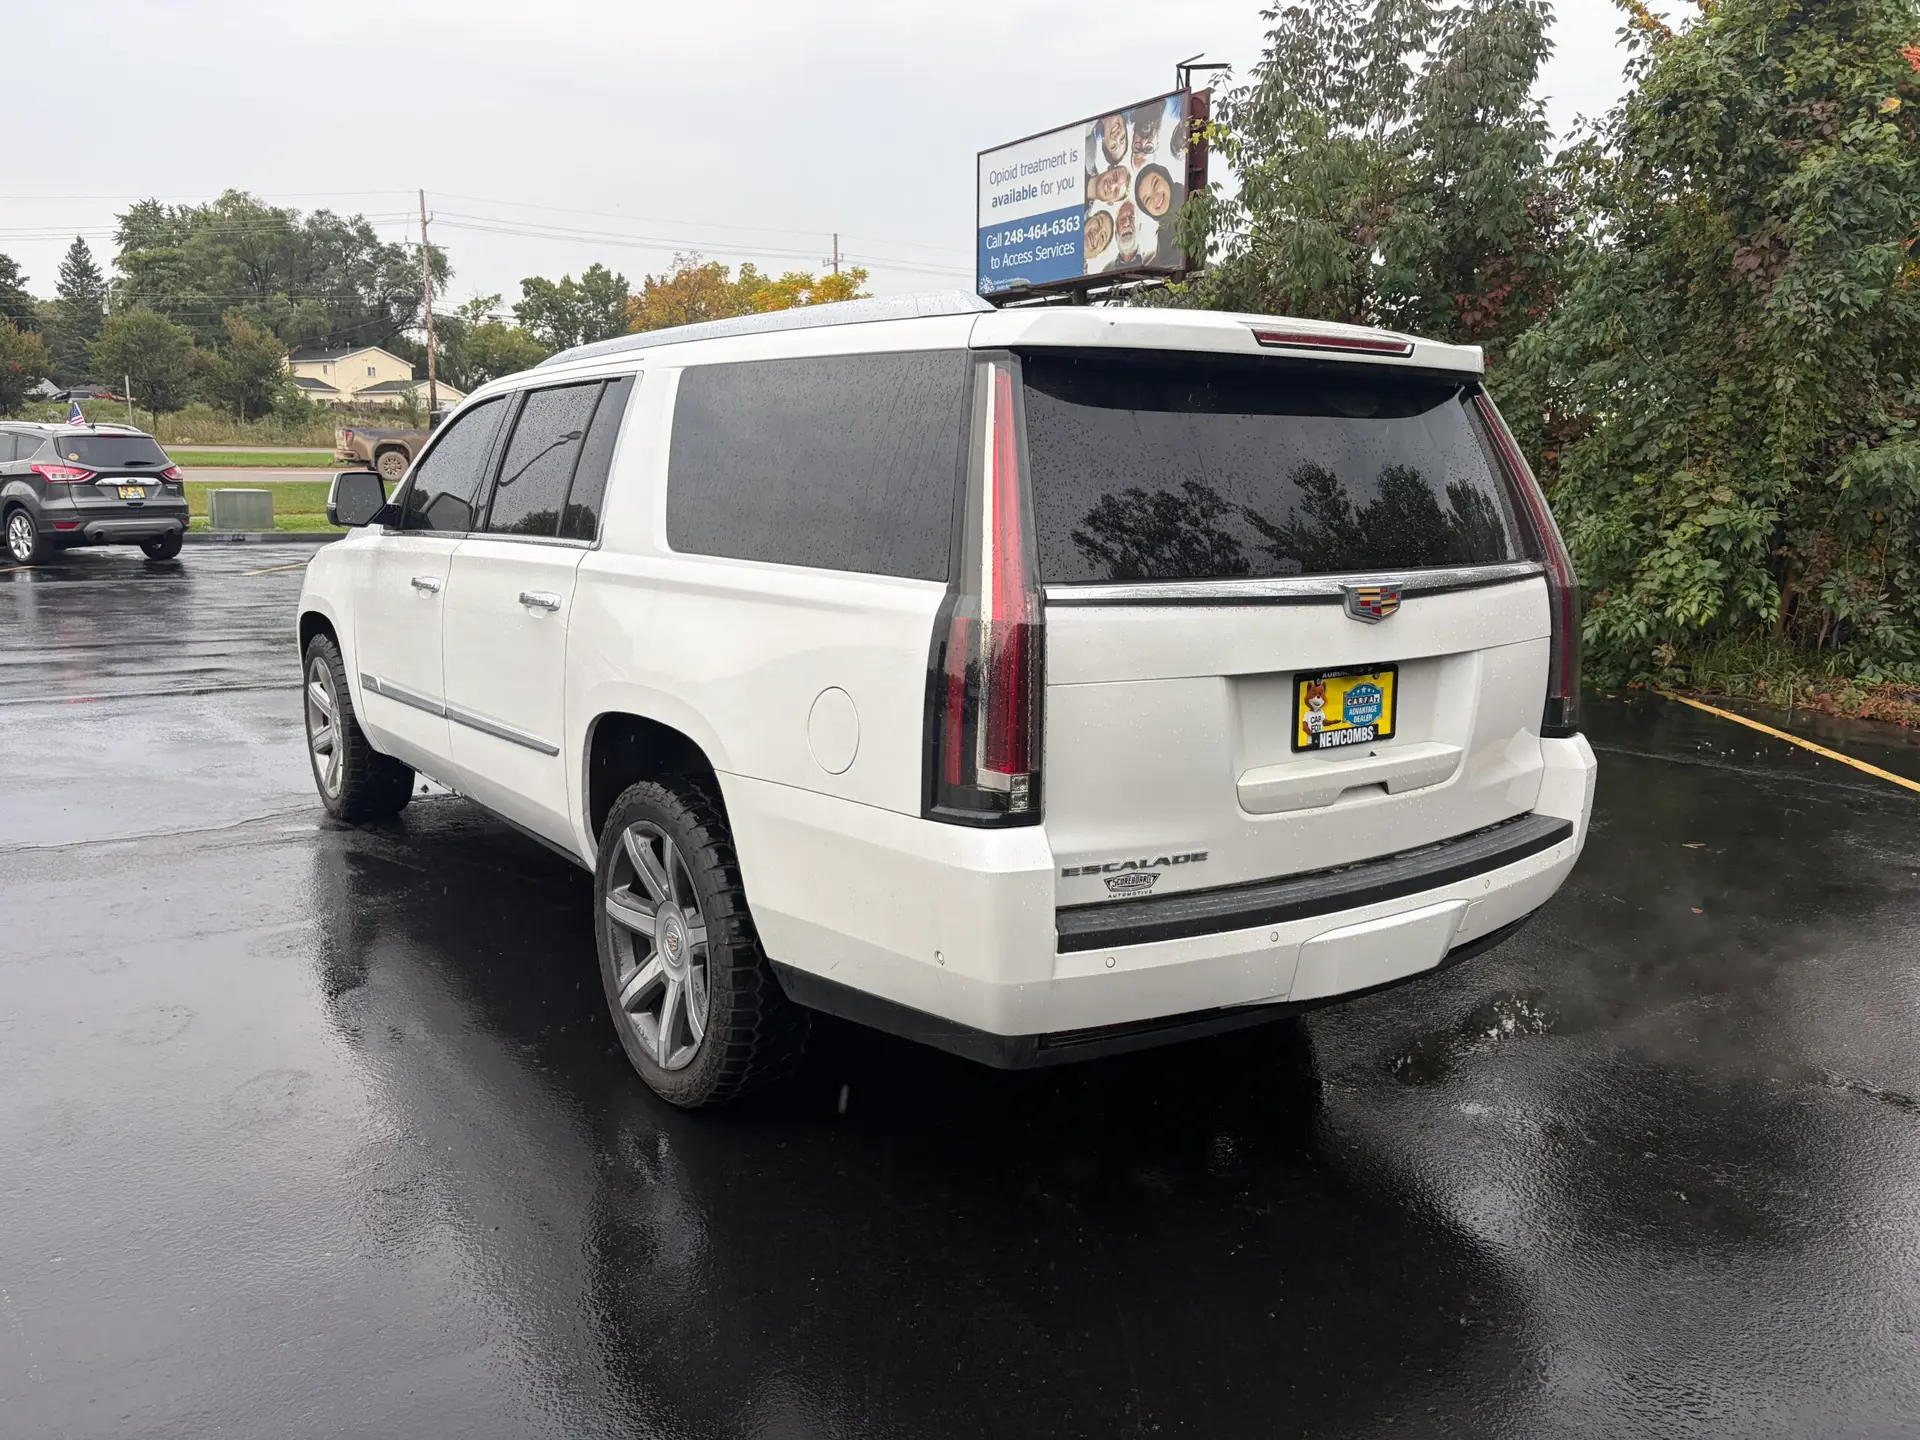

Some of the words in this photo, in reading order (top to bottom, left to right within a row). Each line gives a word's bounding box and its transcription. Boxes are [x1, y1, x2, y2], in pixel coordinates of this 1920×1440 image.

[989, 164, 1018, 187] Opioid
[1020, 150, 1067, 176] treatment
[1069, 148, 1078, 163] is
[991, 184, 1038, 208] available
[1040, 180, 1054, 196] for
[1056, 176, 1075, 195] you
[986, 232, 1003, 250] Call
[1004, 215, 1081, 246] 248-464-6363
[990, 255, 1000, 270] to
[1002, 250, 1033, 268] Access
[1035, 242, 1075, 261] Services
[1347, 694, 1380, 706] CARFAX
[1349, 705, 1378, 716] ADVANTAGE
[1353, 713, 1373, 723] DEALER
[1319, 725, 1374, 748] NEWCOMBS
[1061, 850, 1209, 878] ESCALADE
[1111, 873, 1151, 888] SCOREBOARD
[1107, 889, 1153, 898] AUTOMOTIVE
